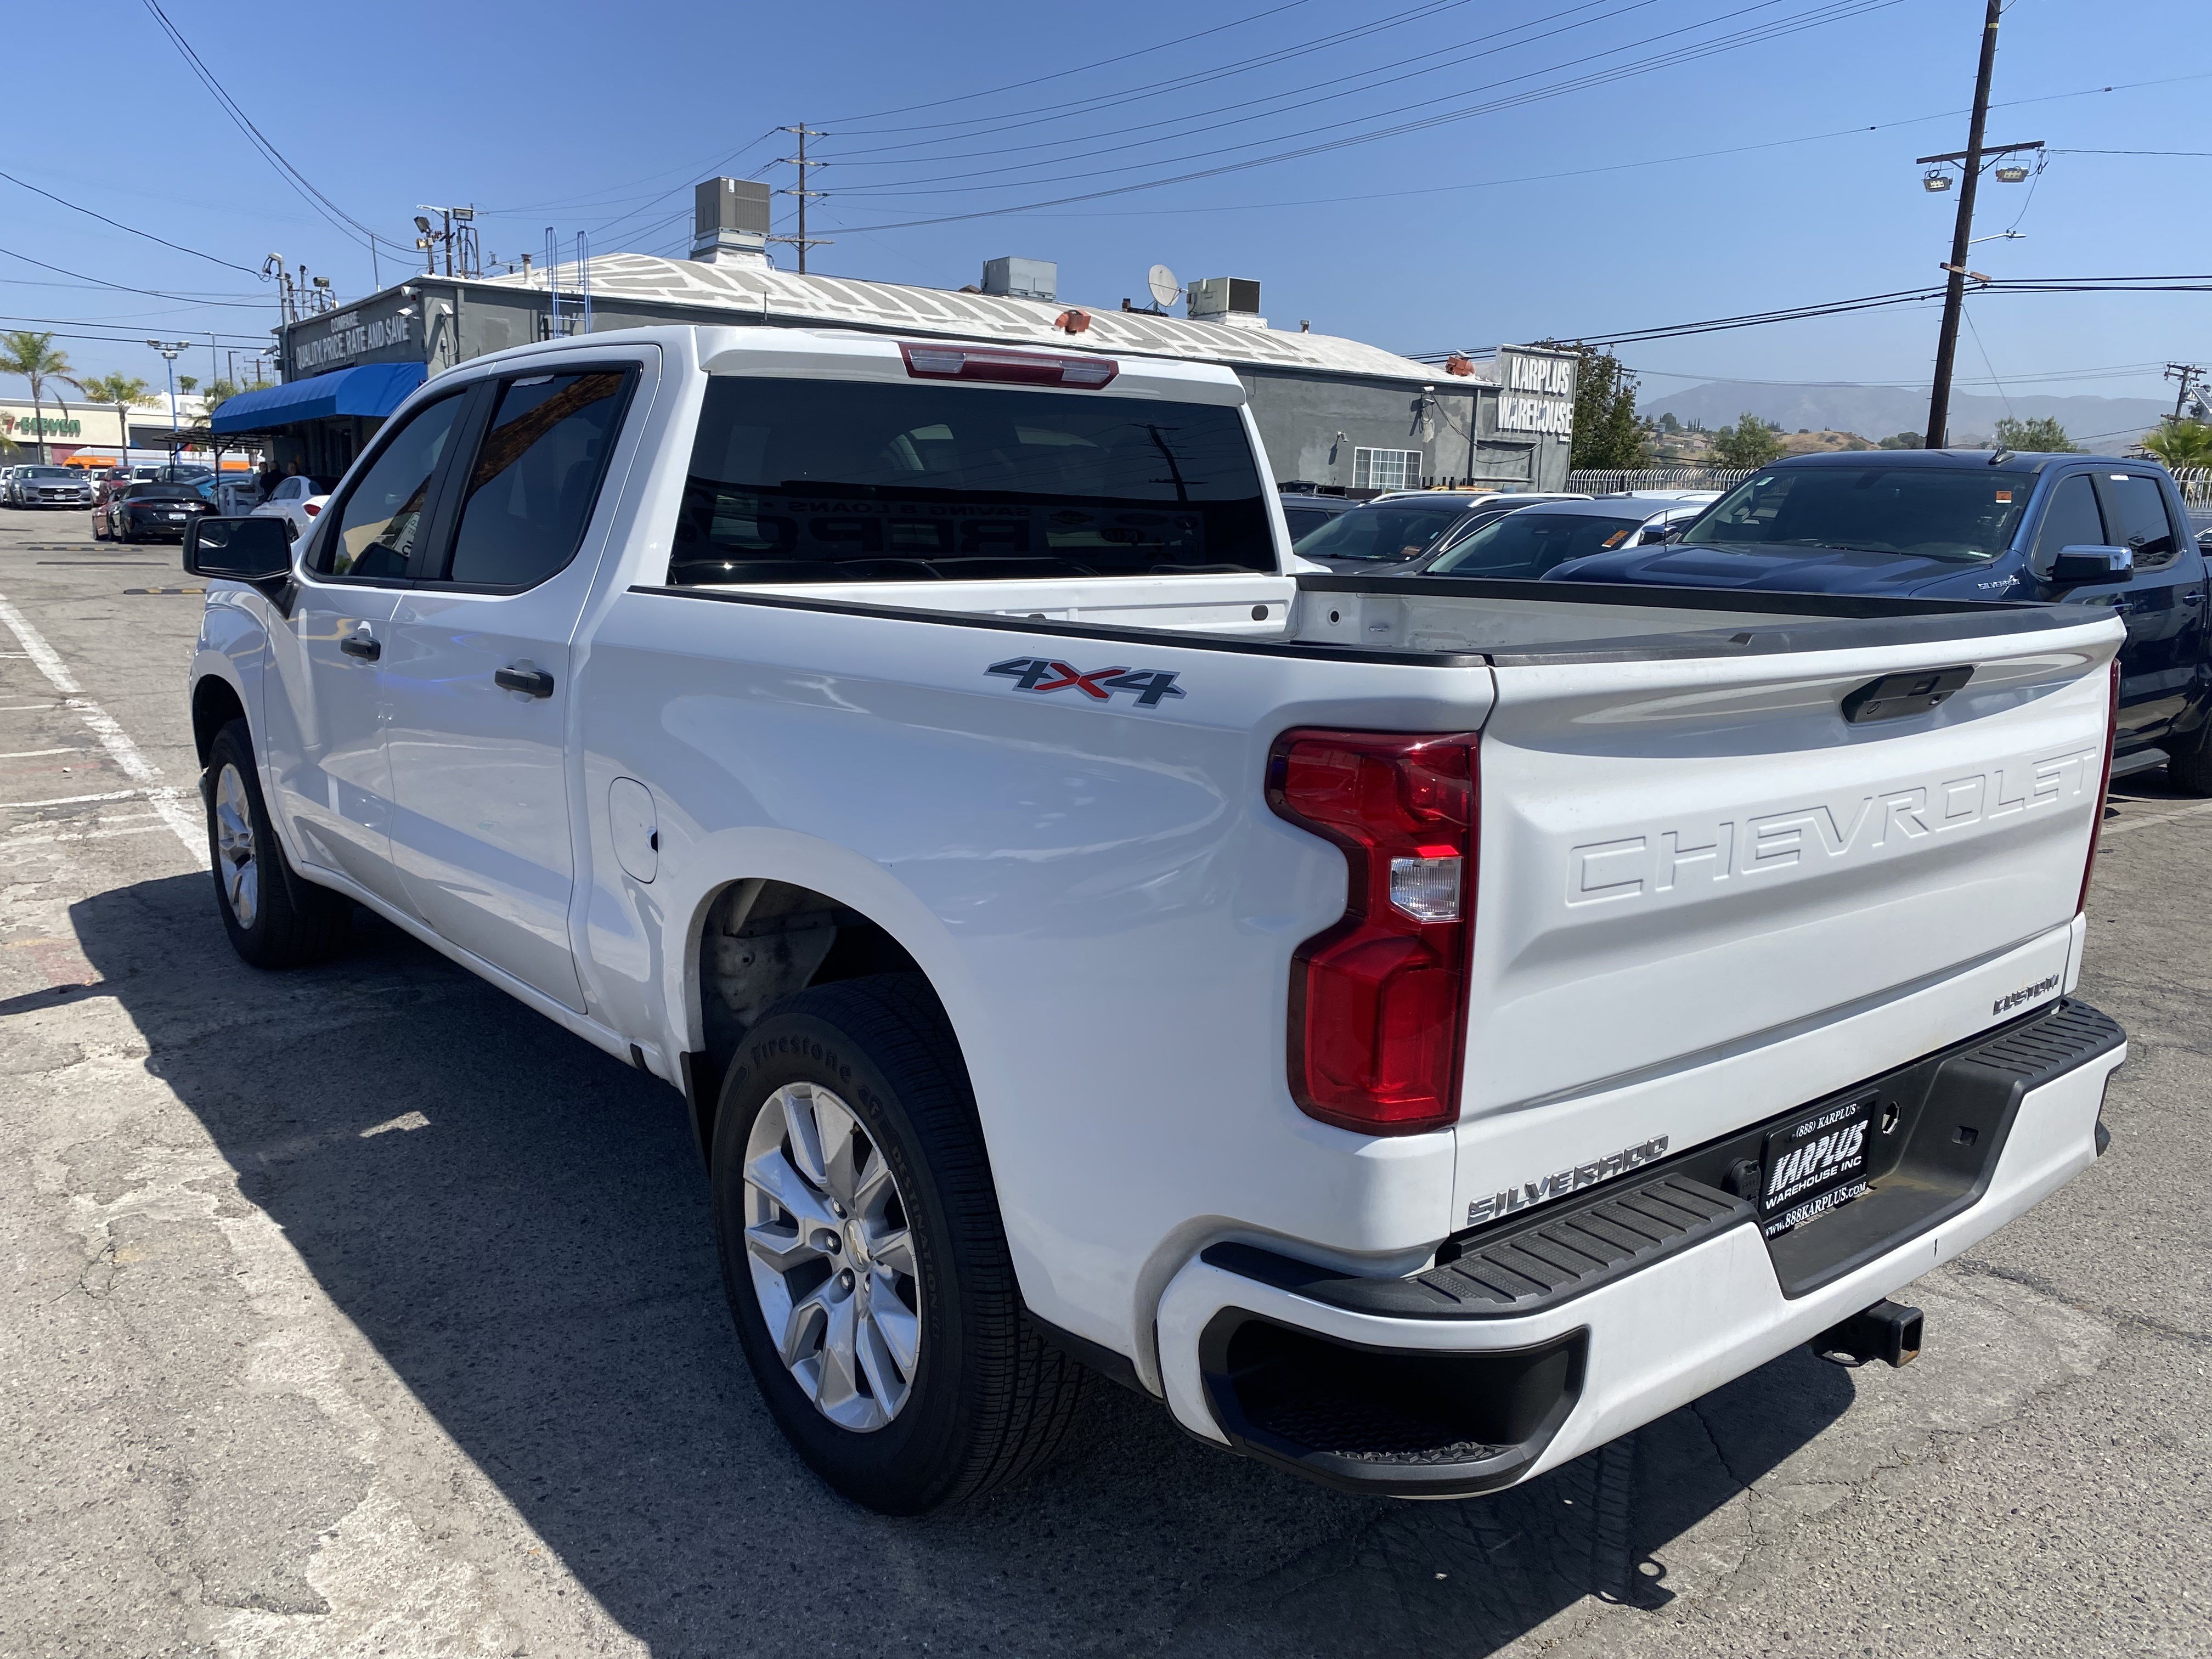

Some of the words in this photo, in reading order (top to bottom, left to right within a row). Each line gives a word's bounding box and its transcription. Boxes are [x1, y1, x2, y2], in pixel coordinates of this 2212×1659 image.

[331, 311, 360, 332] COMPARE
[346, 326, 366, 356] RATE
[368, 320, 383, 350] AND
[386, 315, 410, 346] SAVE
[1510, 357, 1570, 394] KARPLUS
[1498, 396, 1574, 434] WAREHOUSE
[1565, 747, 2096, 908] CHEVROLET
[751, 1034, 853, 1080] Firestone
[1796, 1121, 1816, 1138] (888)
[1816, 1103, 1857, 1130] KARPLUS
[1468, 1133, 1669, 1221] SILVERADO
[1767, 1120, 1869, 1195] KARPLUS
[1765, 1165, 1838, 1210] WAREHOUSE
[1841, 1156, 1862, 1171] INC
[892, 1146, 940, 1308] DESTINATION
